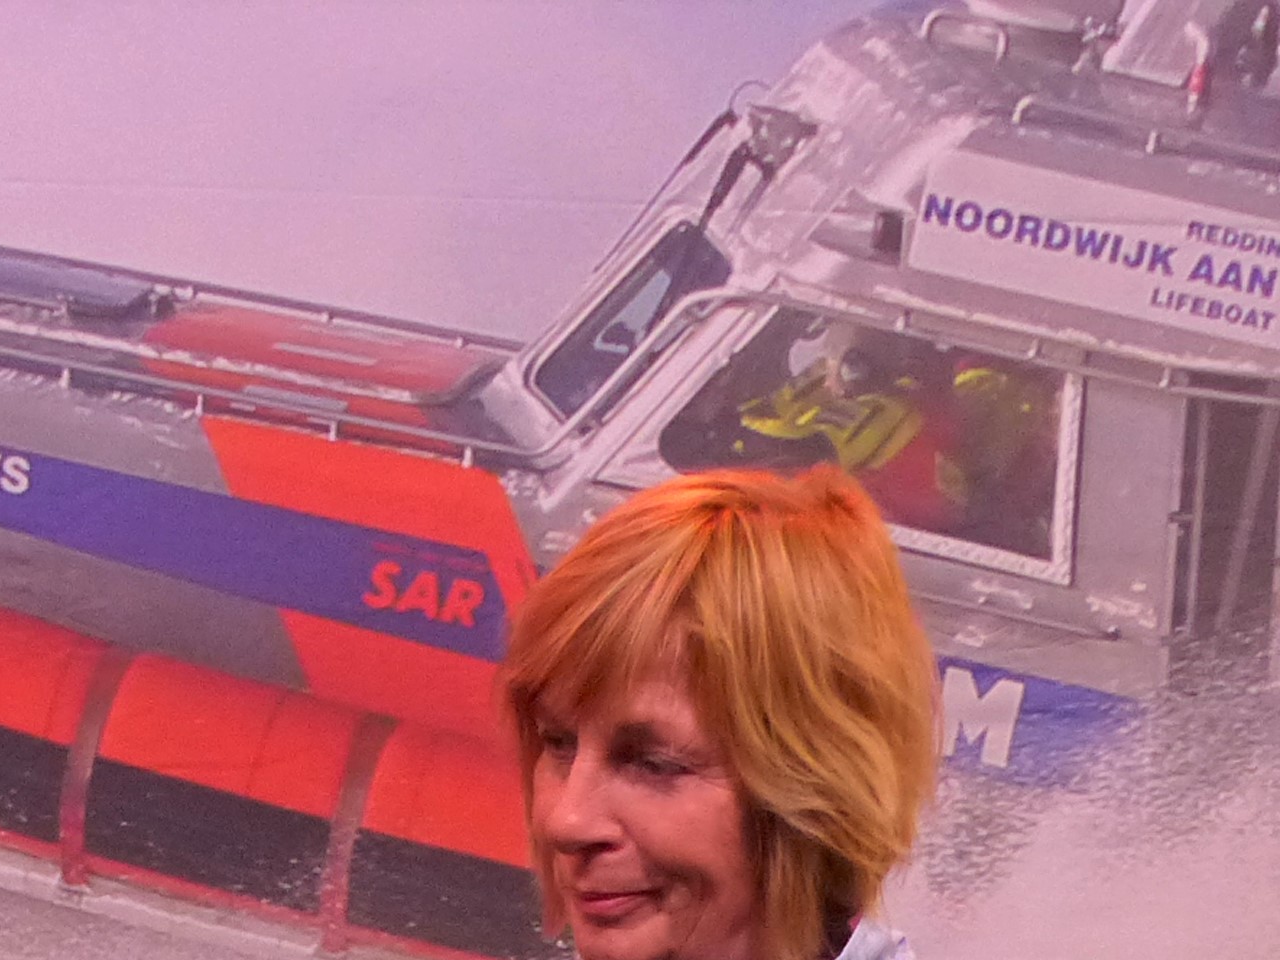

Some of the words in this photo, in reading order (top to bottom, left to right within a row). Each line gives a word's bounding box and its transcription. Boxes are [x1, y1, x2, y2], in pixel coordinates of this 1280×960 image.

[922, 193, 1178, 276] NOORDWIJK
[1187, 253, 1278, 298] AAN
[1150, 287, 1276, 331] LIFEBOAT
[362, 561, 485, 628] SAR
